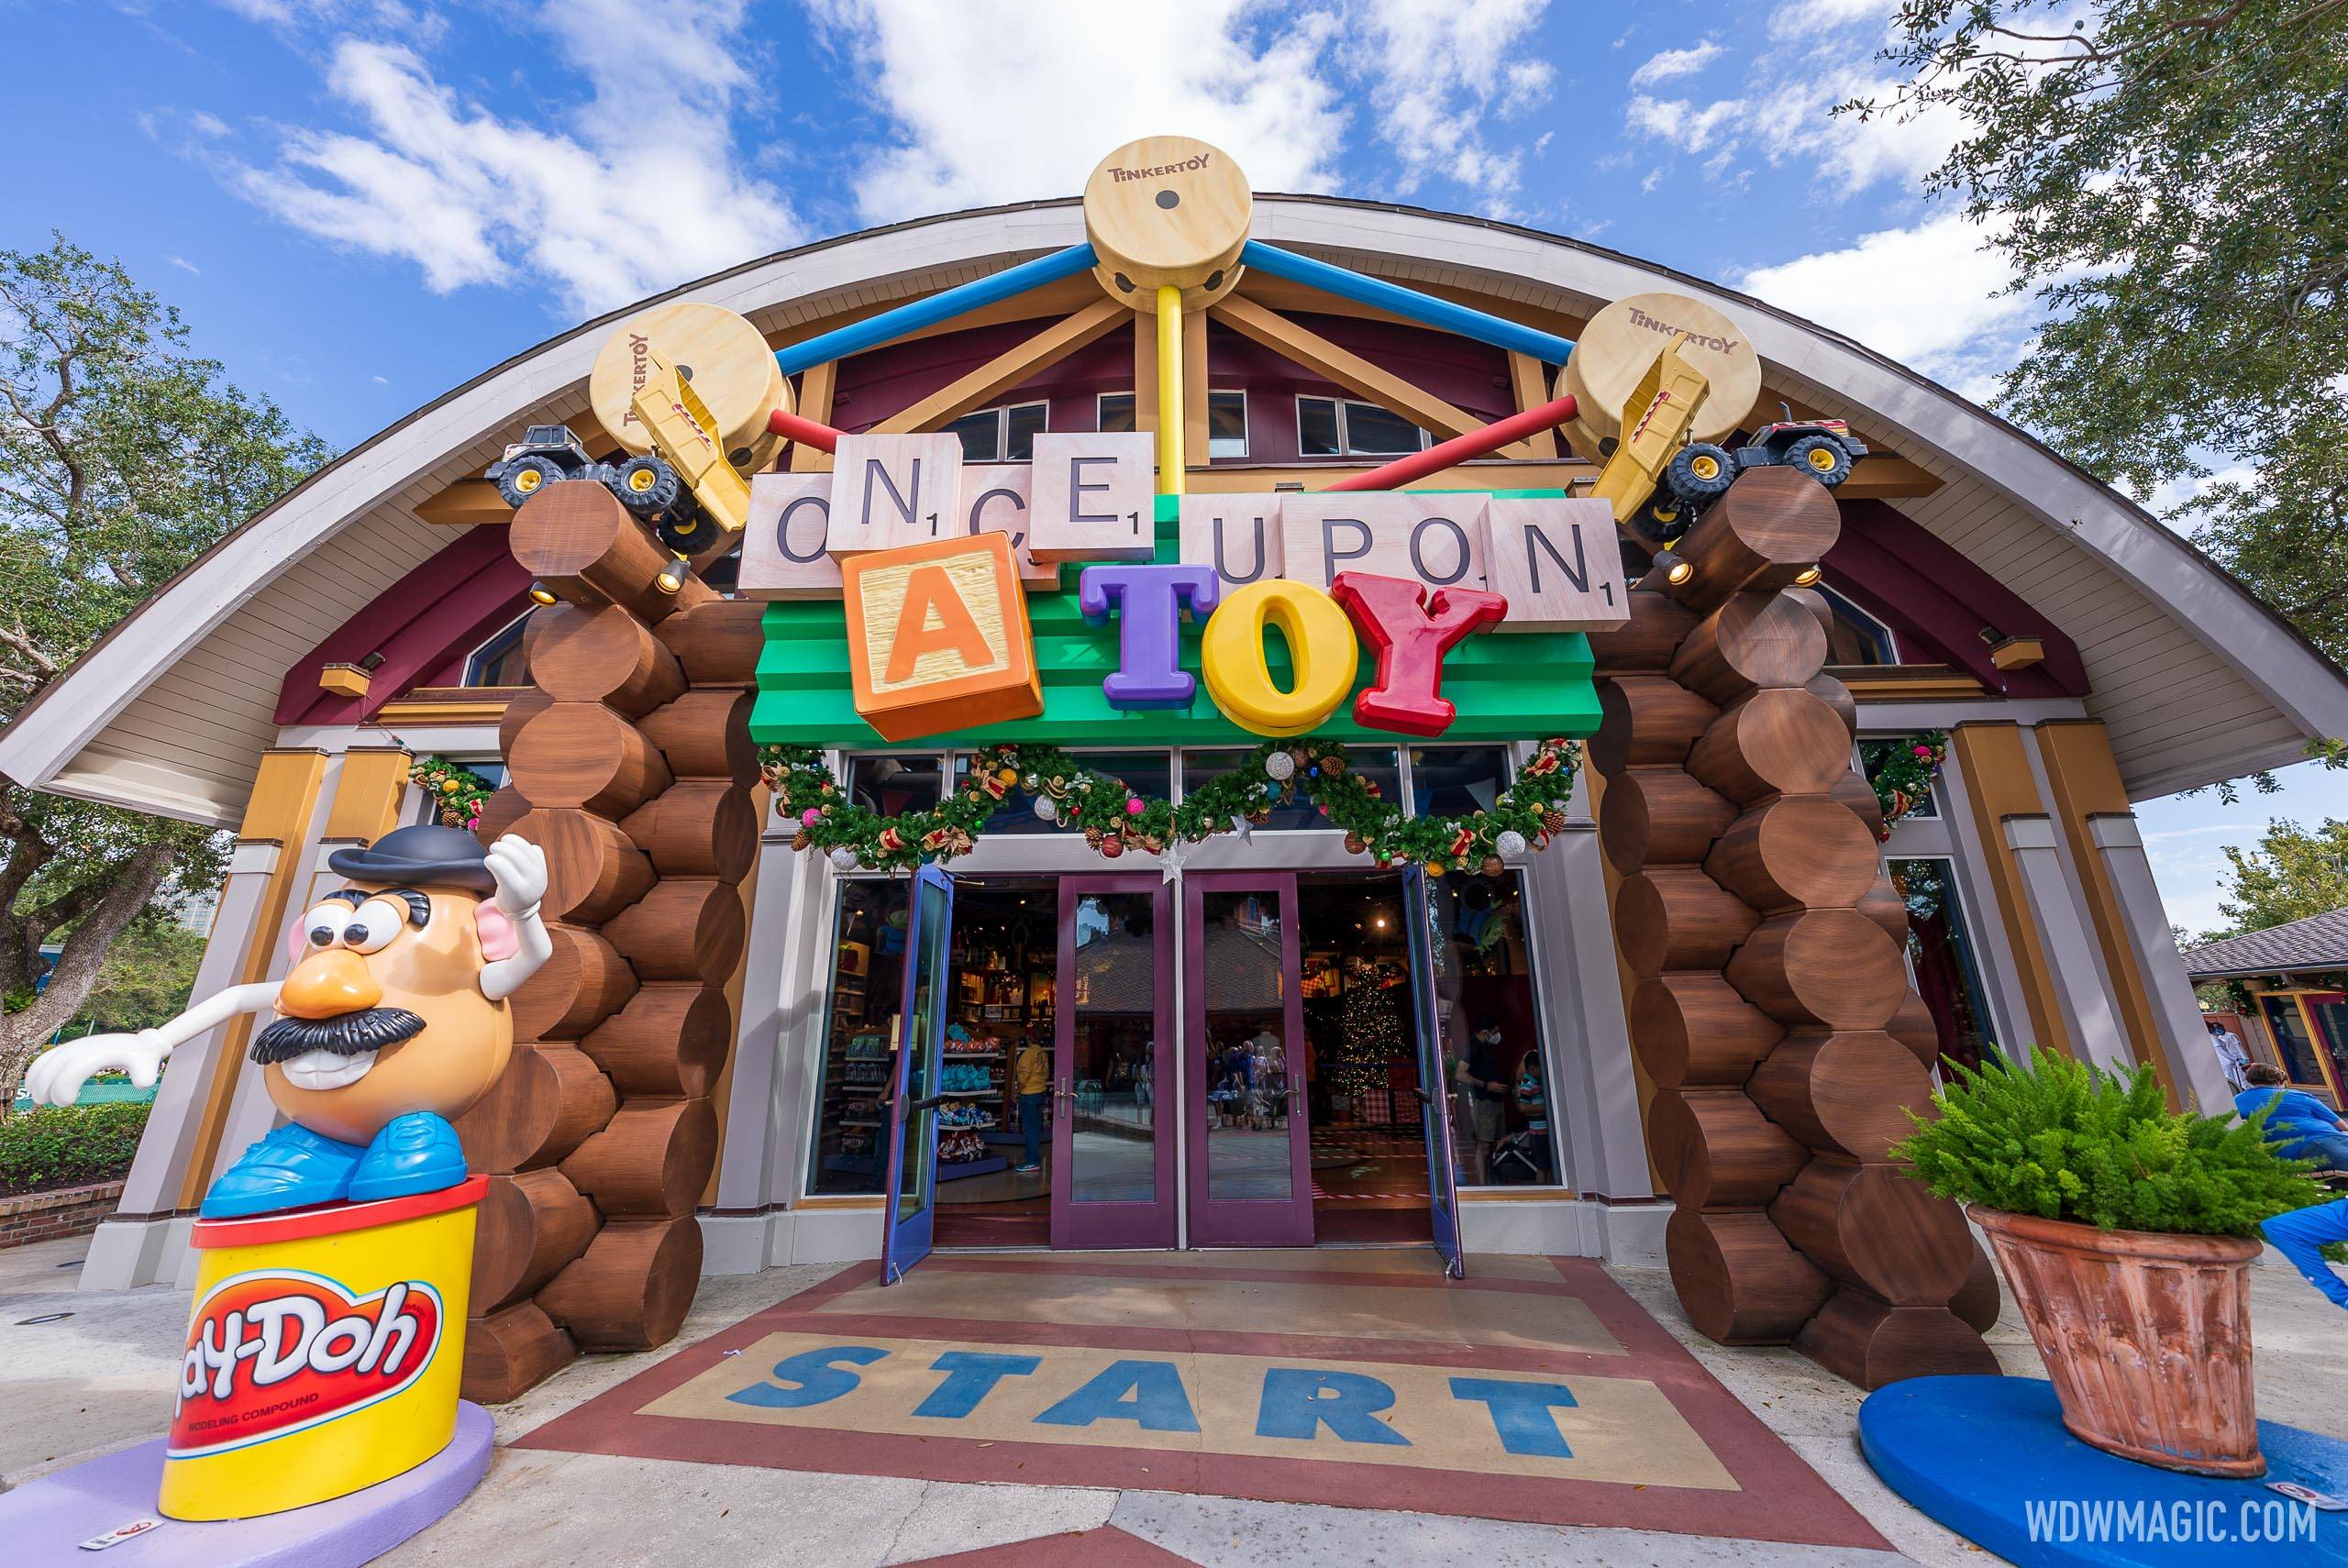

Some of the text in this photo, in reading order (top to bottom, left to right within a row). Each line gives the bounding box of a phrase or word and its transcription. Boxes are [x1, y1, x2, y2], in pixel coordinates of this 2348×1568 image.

[1213, 516, 1590, 594] UPON
[884, 564, 1509, 738] A TOY
[174, 1281, 418, 1419] ay-Doh
[724, 1345, 1579, 1459] START
[188, 1392, 319, 1432] MODELING COMPOUND
